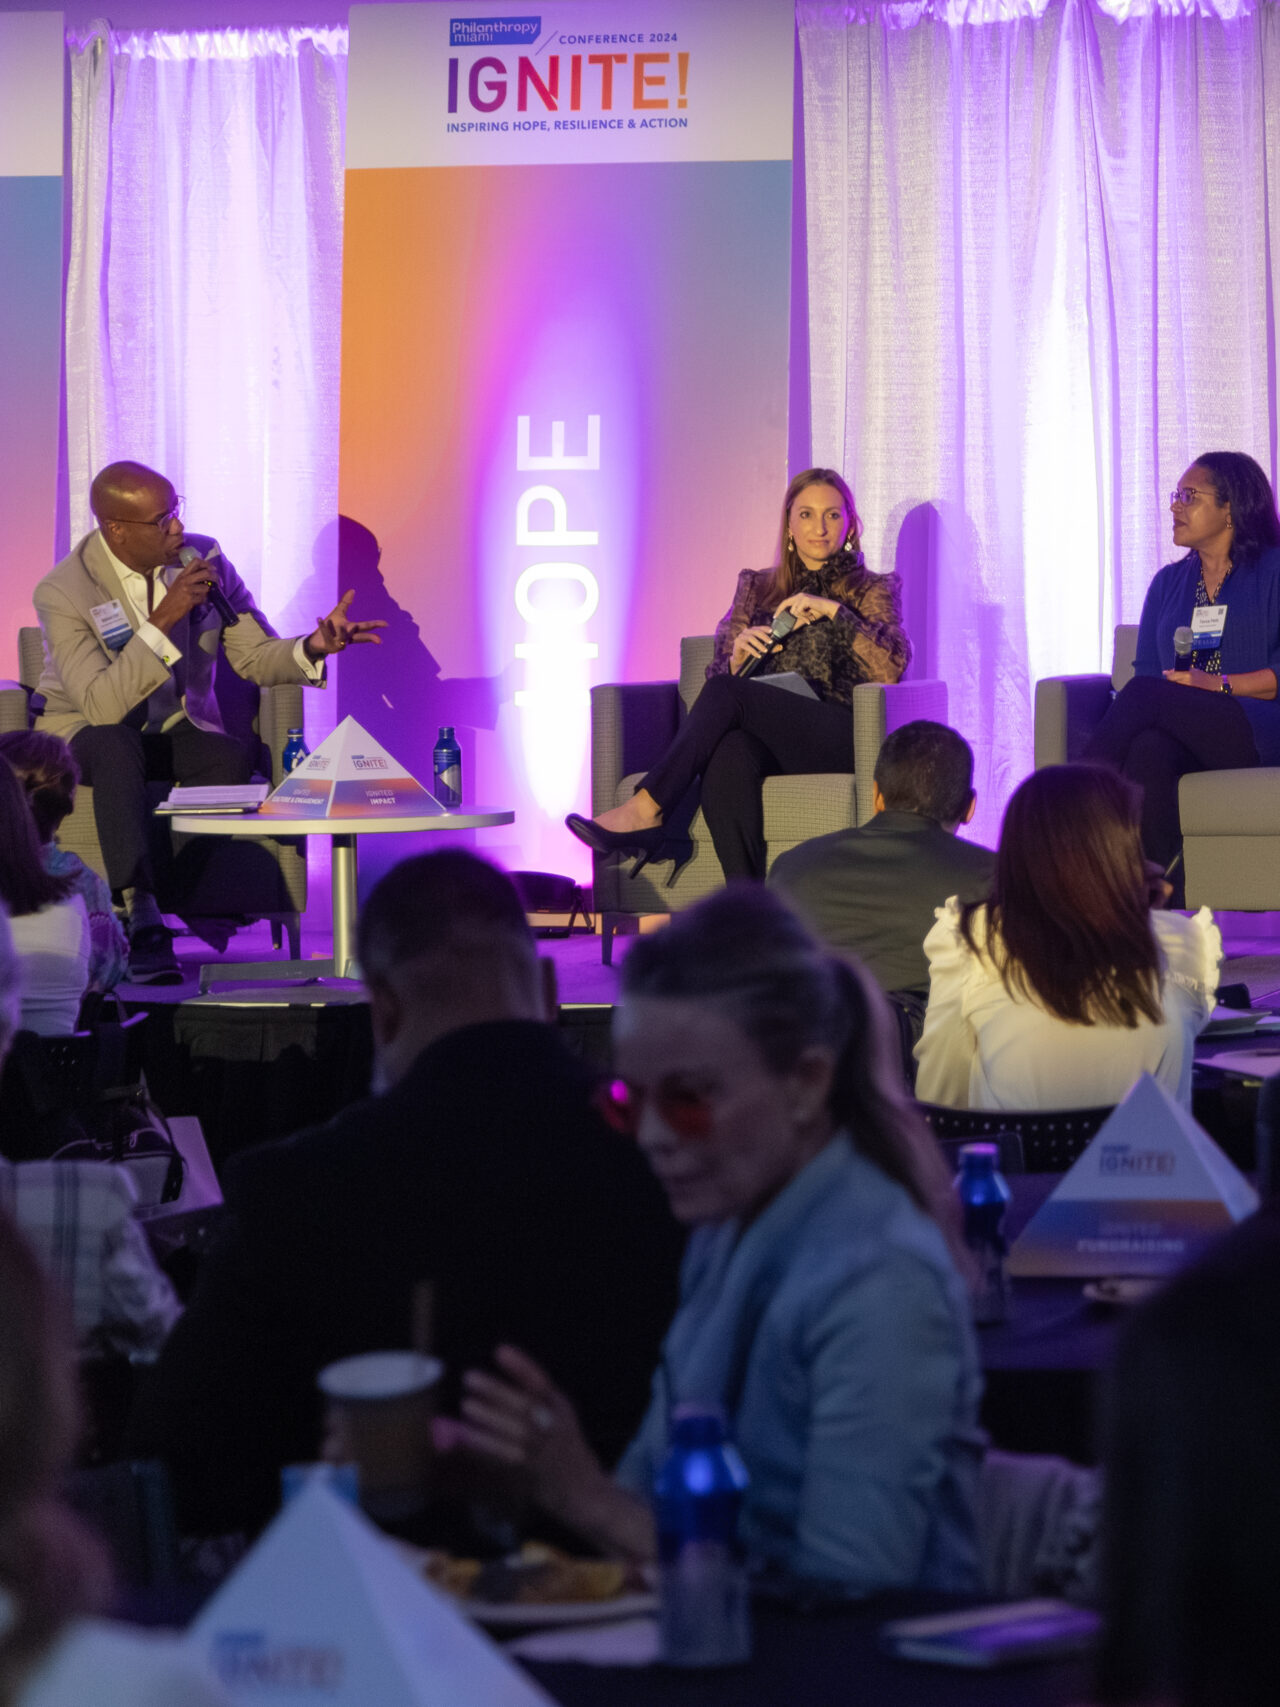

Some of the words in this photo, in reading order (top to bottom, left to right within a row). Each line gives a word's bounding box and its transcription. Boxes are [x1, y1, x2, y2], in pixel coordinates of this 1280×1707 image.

[452, 20, 538, 34] Philanthropy
[454, 32, 493, 43] miami
[558, 34, 644, 45] CONFERENCE
[649, 32, 678, 43] 2024
[447, 52, 690, 114] IGNITE!
[447, 121, 509, 133] INSPIRING
[513, 120, 551, 132] HOPE,
[554, 119, 624, 131] RESILIENCE
[627, 119, 637, 129] &
[639, 118, 688, 129] ACTION
[370, 797, 396, 805] IMPACT
